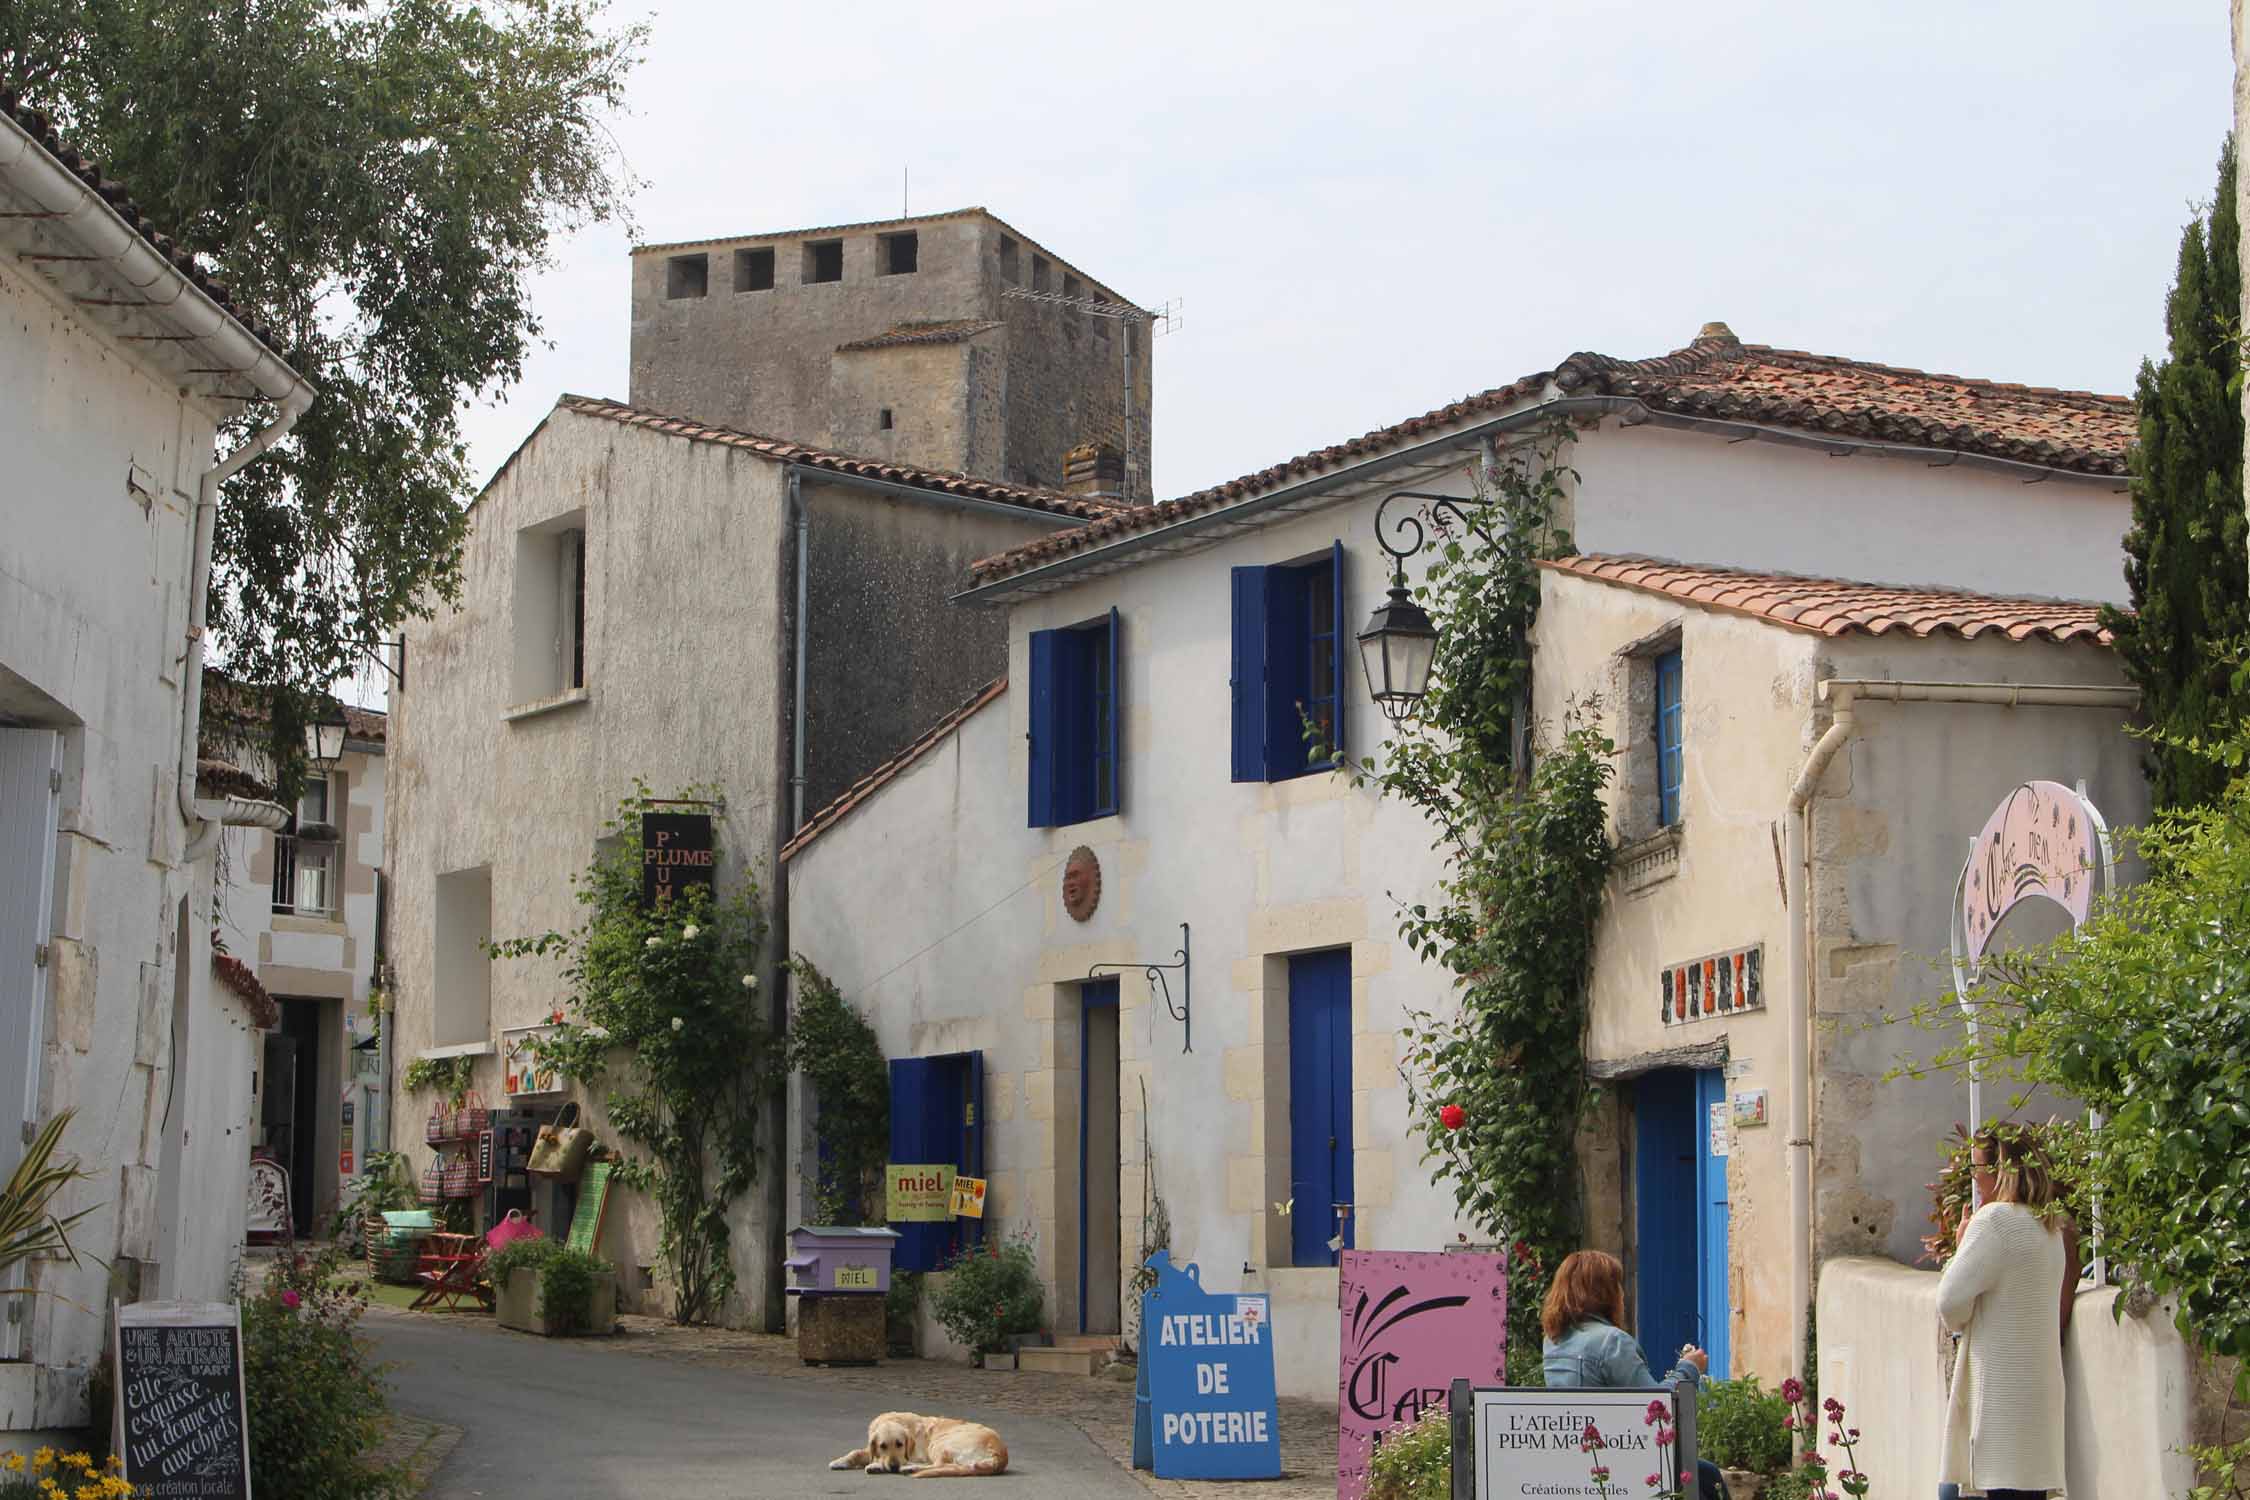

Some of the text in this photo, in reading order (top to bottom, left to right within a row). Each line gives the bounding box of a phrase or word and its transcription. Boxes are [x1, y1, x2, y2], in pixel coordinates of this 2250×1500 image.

[643, 848, 713, 867] PLUME
[898, 1171, 945, 1192] miel
[954, 1178, 975, 1190] MIEL
[841, 1271, 869, 1285] MIEL
[125, 1329, 231, 1347] UNE ARTISTE
[1160, 1314, 1260, 1346] ATELIER
[164, 1347, 231, 1365] ARTISAN
[191, 1364, 231, 1376] D'ART
[1196, 1363, 1229, 1394] DE
[127, 1377, 162, 1409] Elle
[163, 1406, 209, 1446] donne
[208, 1391, 234, 1416] vie
[1163, 1411, 1269, 1445] POTERIE
[162, 1416, 239, 1477] aux objets
[1520, 1482, 1582, 1496] Créations
